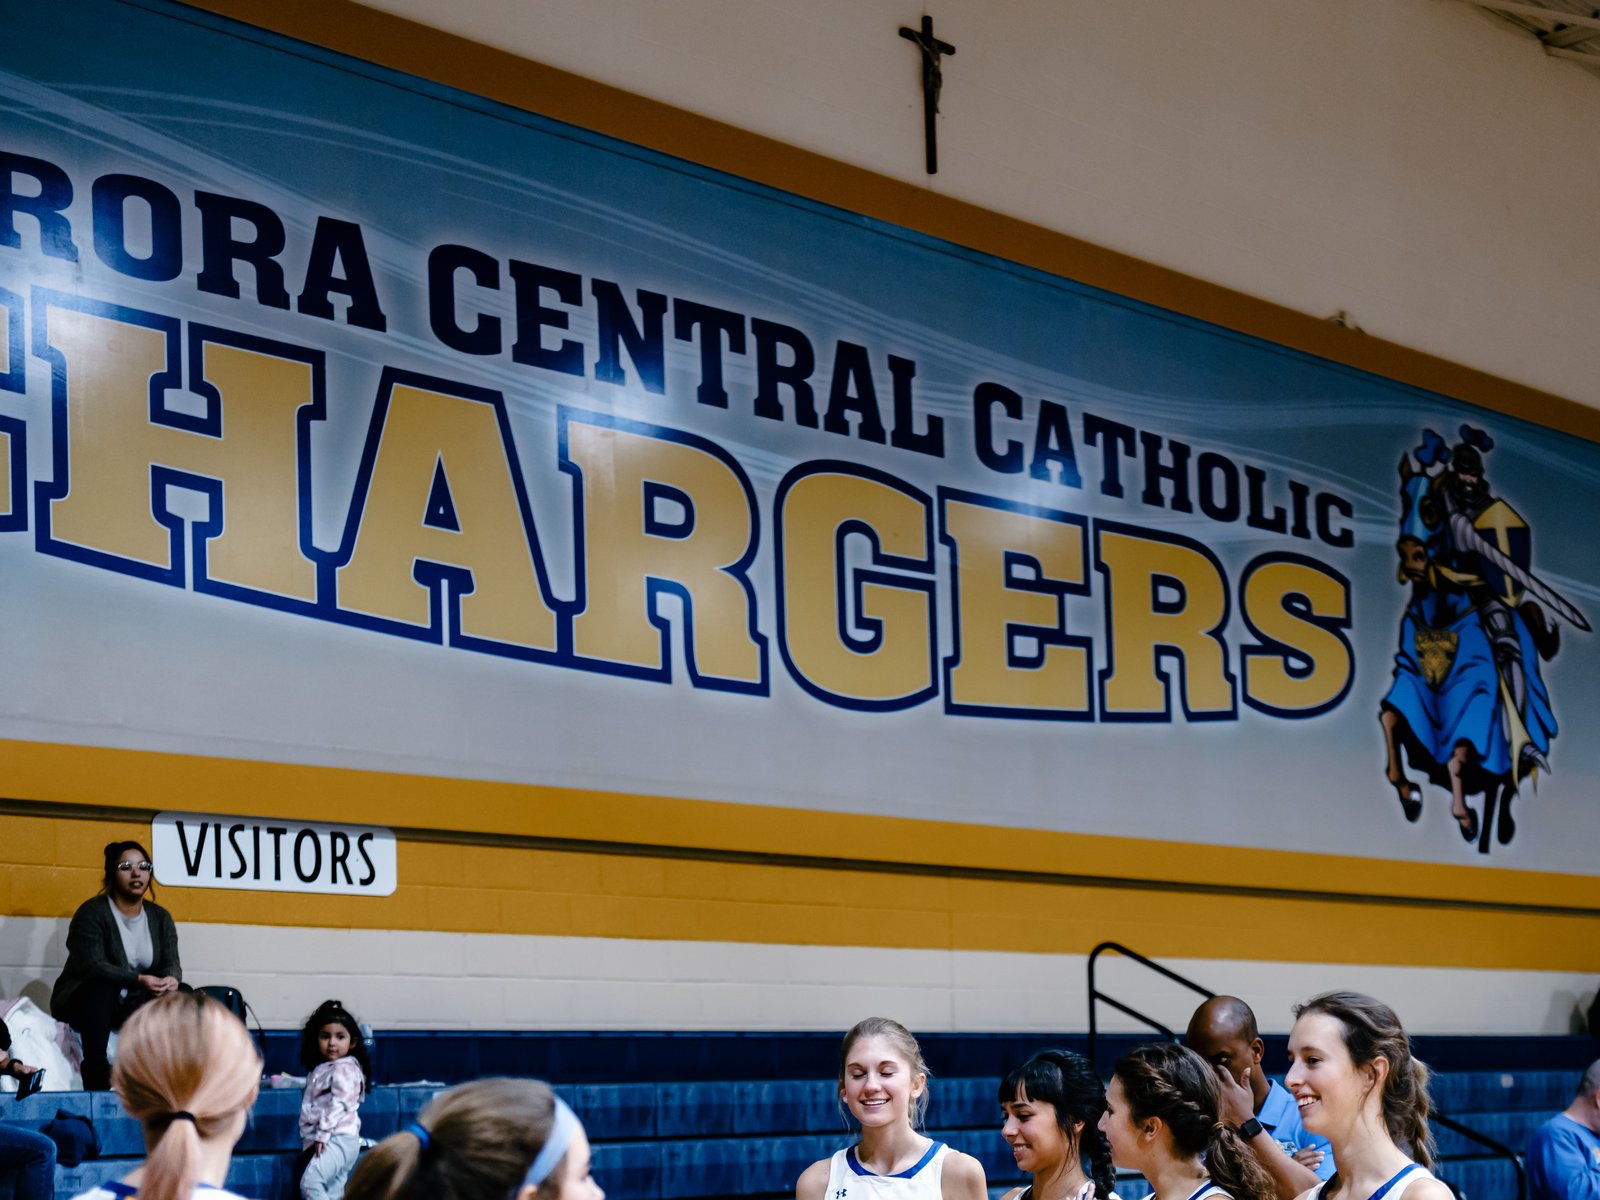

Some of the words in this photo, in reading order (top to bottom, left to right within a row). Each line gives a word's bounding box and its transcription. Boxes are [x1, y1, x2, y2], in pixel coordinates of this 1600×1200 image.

[0, 151, 387, 333] RORA
[428, 243, 945, 458] CENTRAL
[973, 382, 1354, 548] CATHOLIC
[0, 283, 1356, 723] HARGERS
[175, 820, 376, 886] VISITORS
